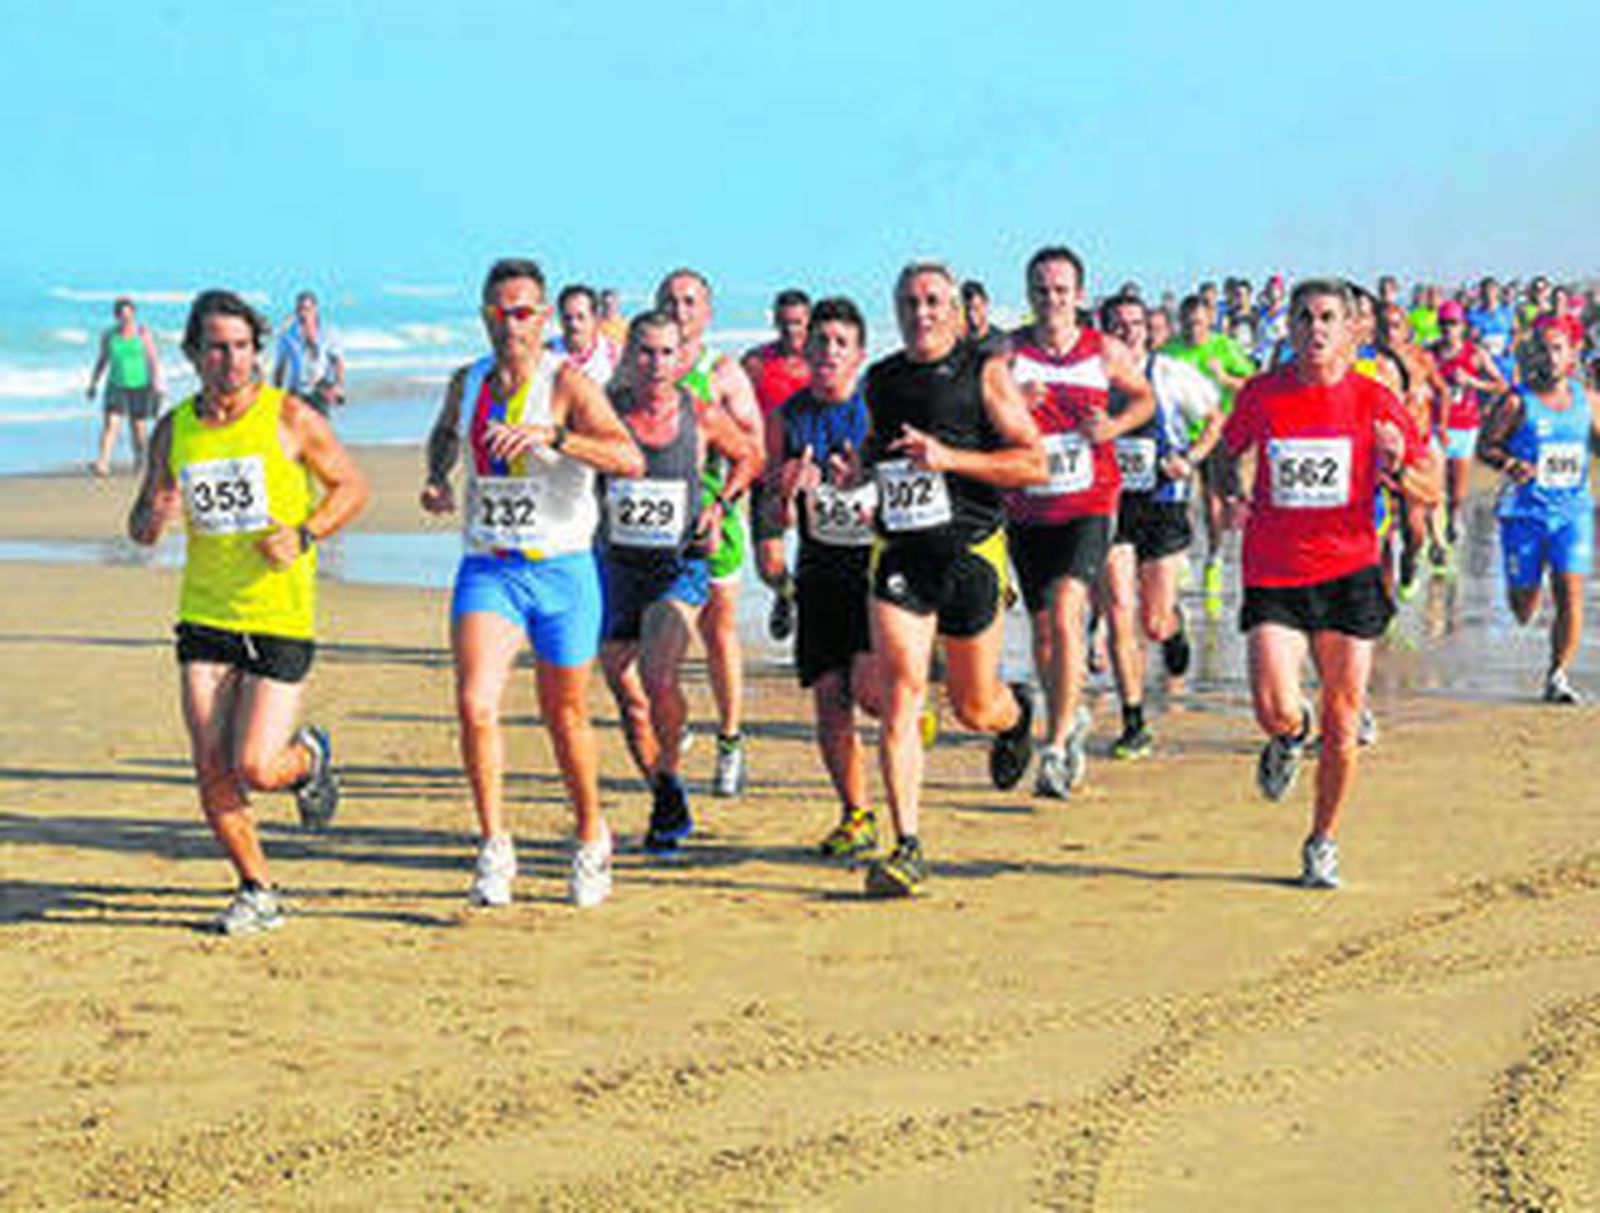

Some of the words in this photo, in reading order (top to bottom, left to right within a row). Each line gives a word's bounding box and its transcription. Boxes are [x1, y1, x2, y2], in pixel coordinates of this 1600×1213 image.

[1280, 457, 1338, 488] 562
[193, 478, 255, 513] 353
[618, 496, 675, 526] 229
